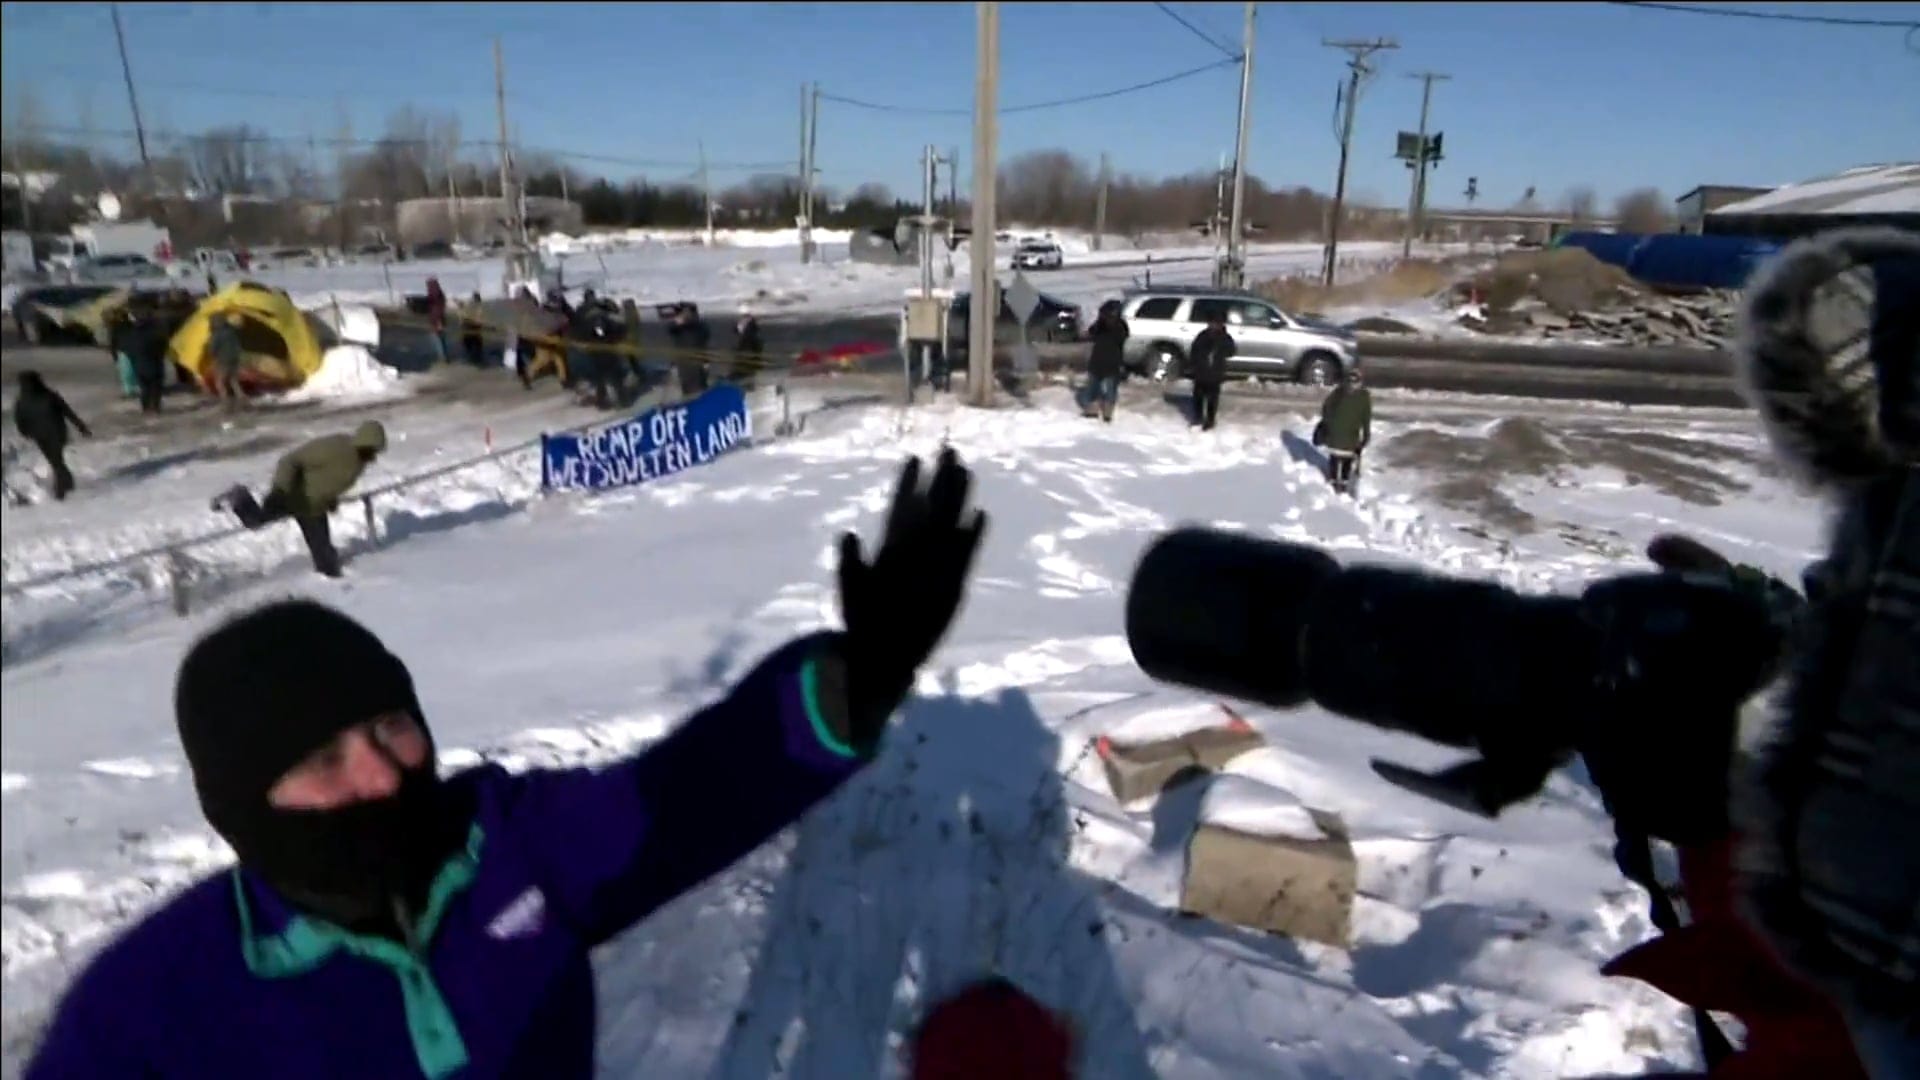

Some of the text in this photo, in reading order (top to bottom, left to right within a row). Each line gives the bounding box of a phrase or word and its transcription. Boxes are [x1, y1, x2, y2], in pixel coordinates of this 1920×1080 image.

[577, 407, 688, 461] RCMP OFF
[694, 411, 742, 462] LAND
